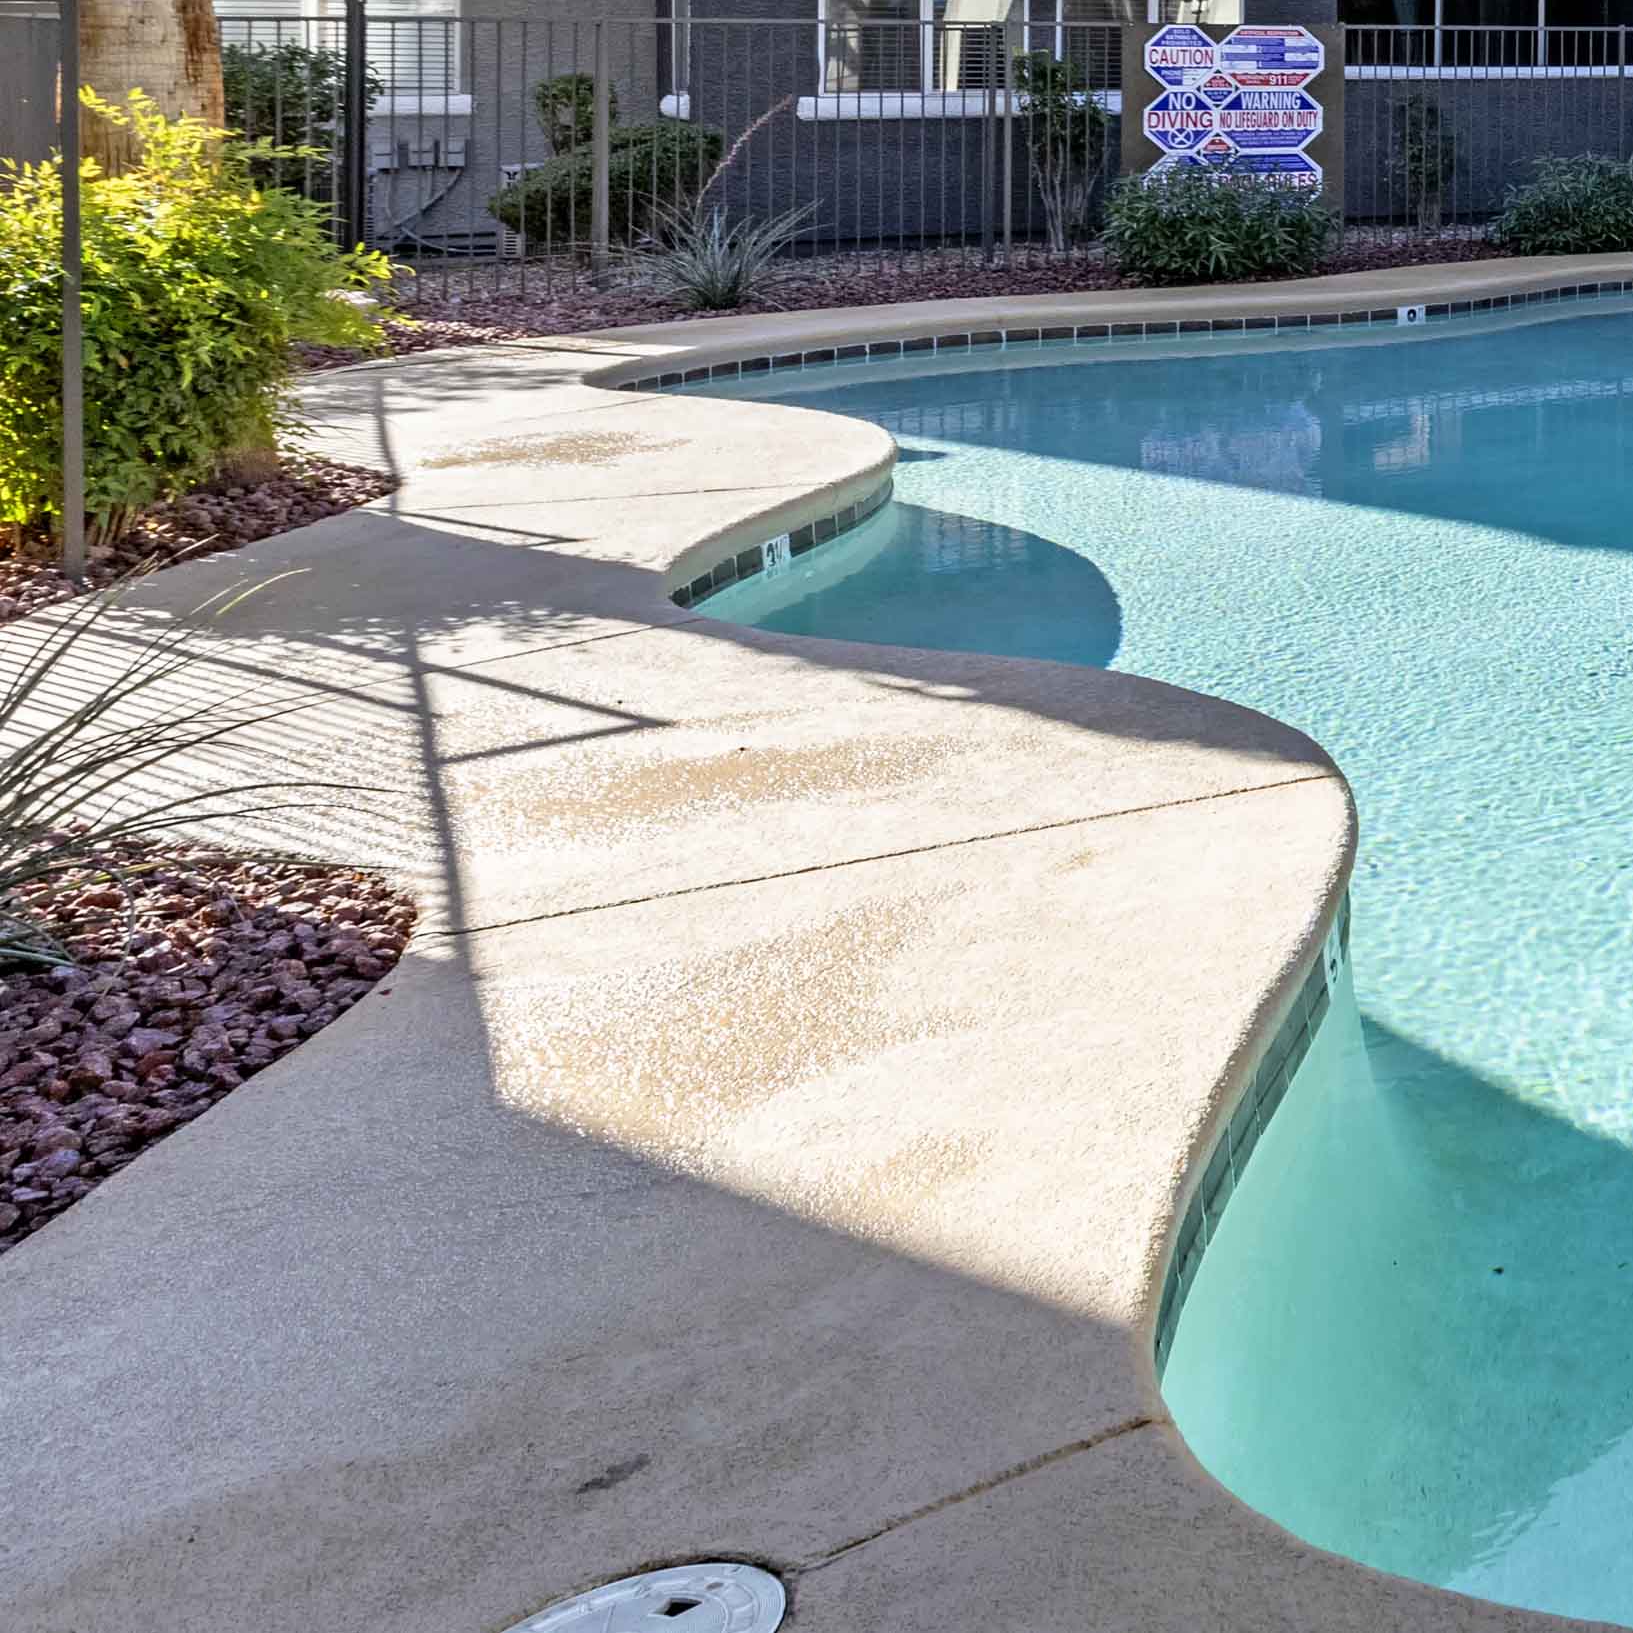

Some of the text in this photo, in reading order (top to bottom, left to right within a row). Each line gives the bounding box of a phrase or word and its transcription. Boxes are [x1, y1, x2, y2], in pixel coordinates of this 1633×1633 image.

[1149, 49, 1214, 65] CAUTION
[1270, 75, 1288, 85] 911
[1169, 93, 1196, 110] NO
[1241, 92, 1301, 109] WARNING
[1148, 111, 1213, 128] DIVING
[1220, 111, 1318, 128] NO LIFEGUARD ON DUTY
